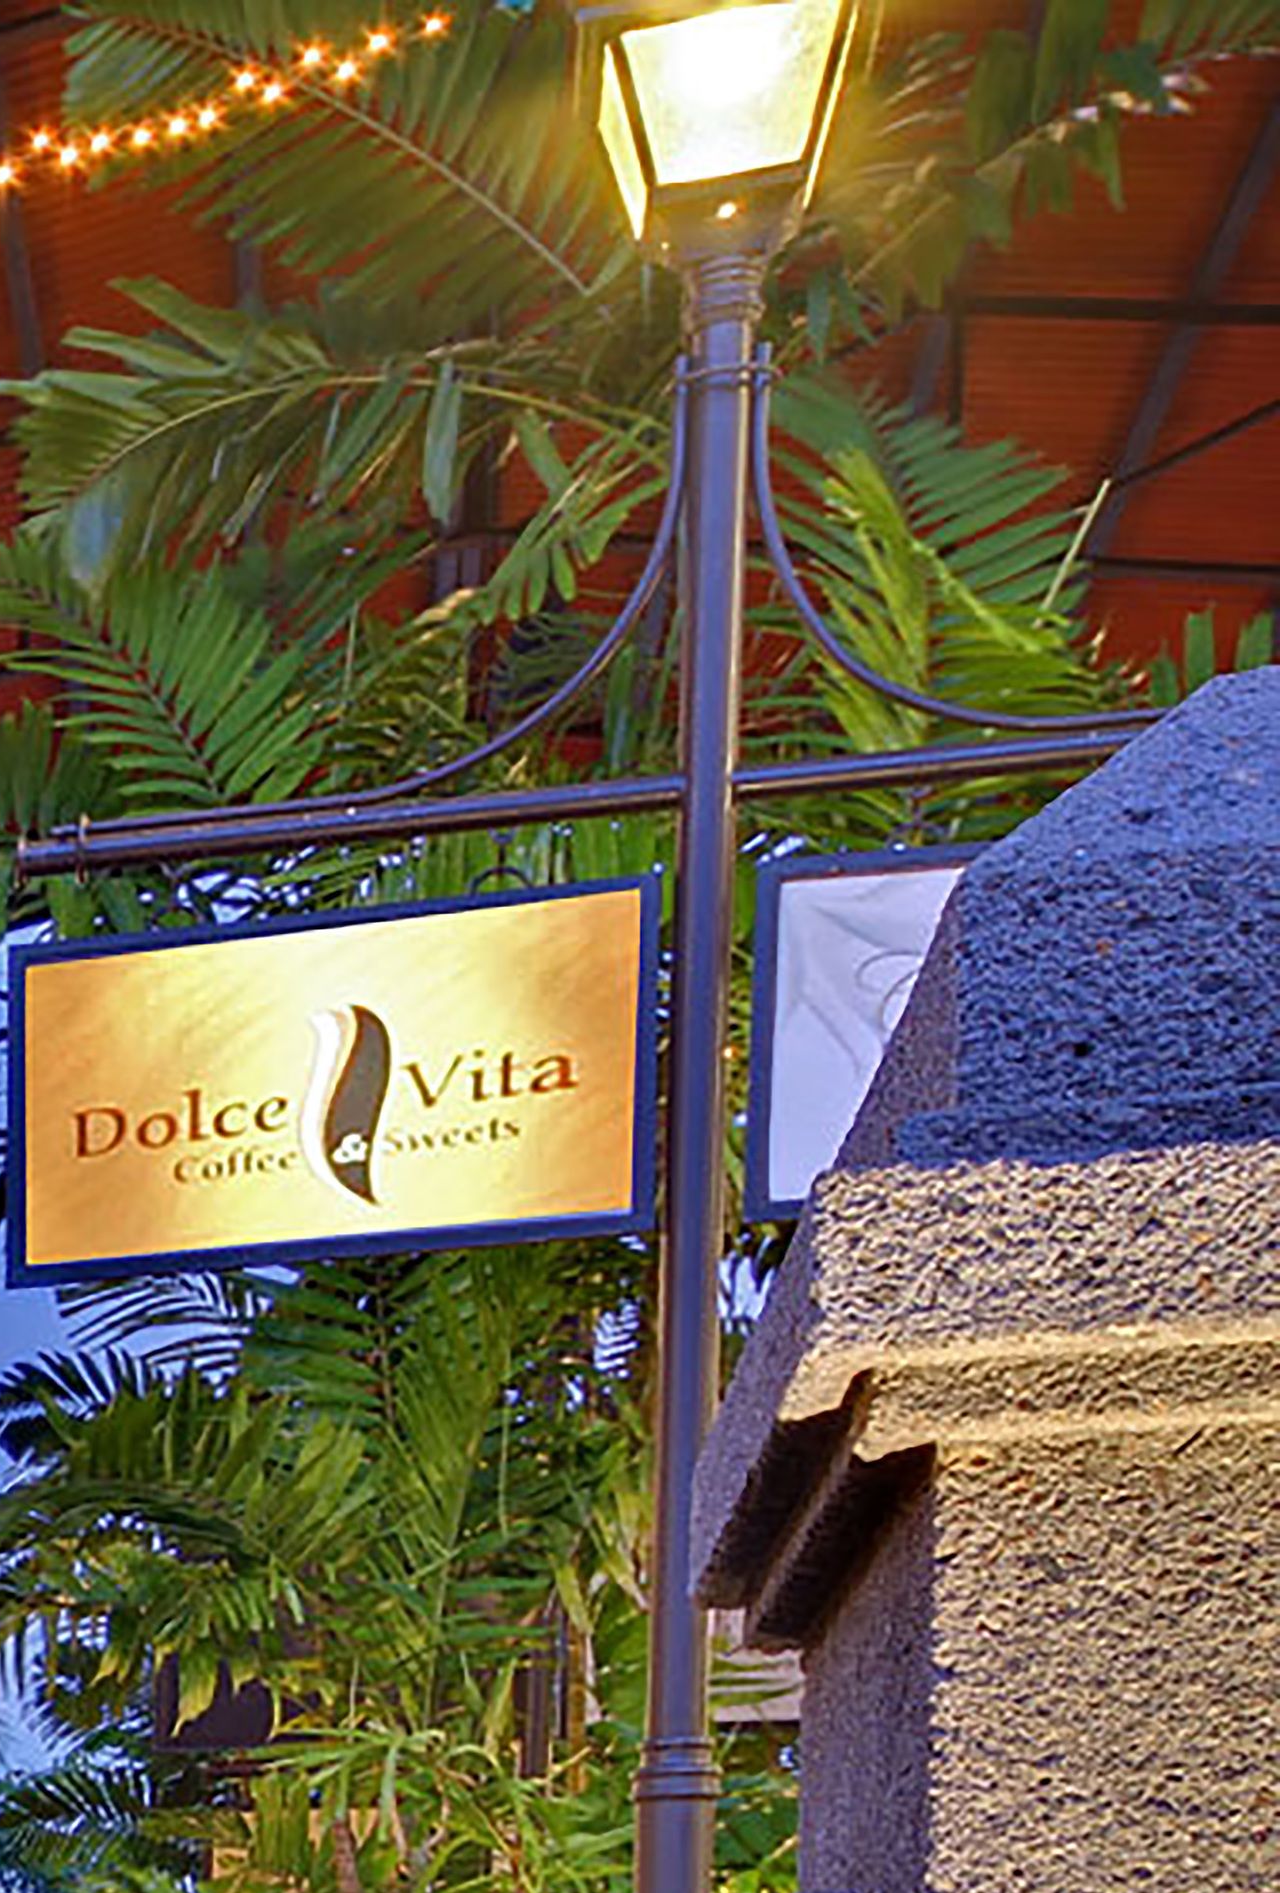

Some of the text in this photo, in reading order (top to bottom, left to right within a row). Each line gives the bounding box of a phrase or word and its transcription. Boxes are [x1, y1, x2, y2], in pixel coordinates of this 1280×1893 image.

[71, 1049, 580, 1160] Dolce Vita
[172, 1146, 300, 1185] Coffee
[383, 1117, 522, 1157] Sweets
